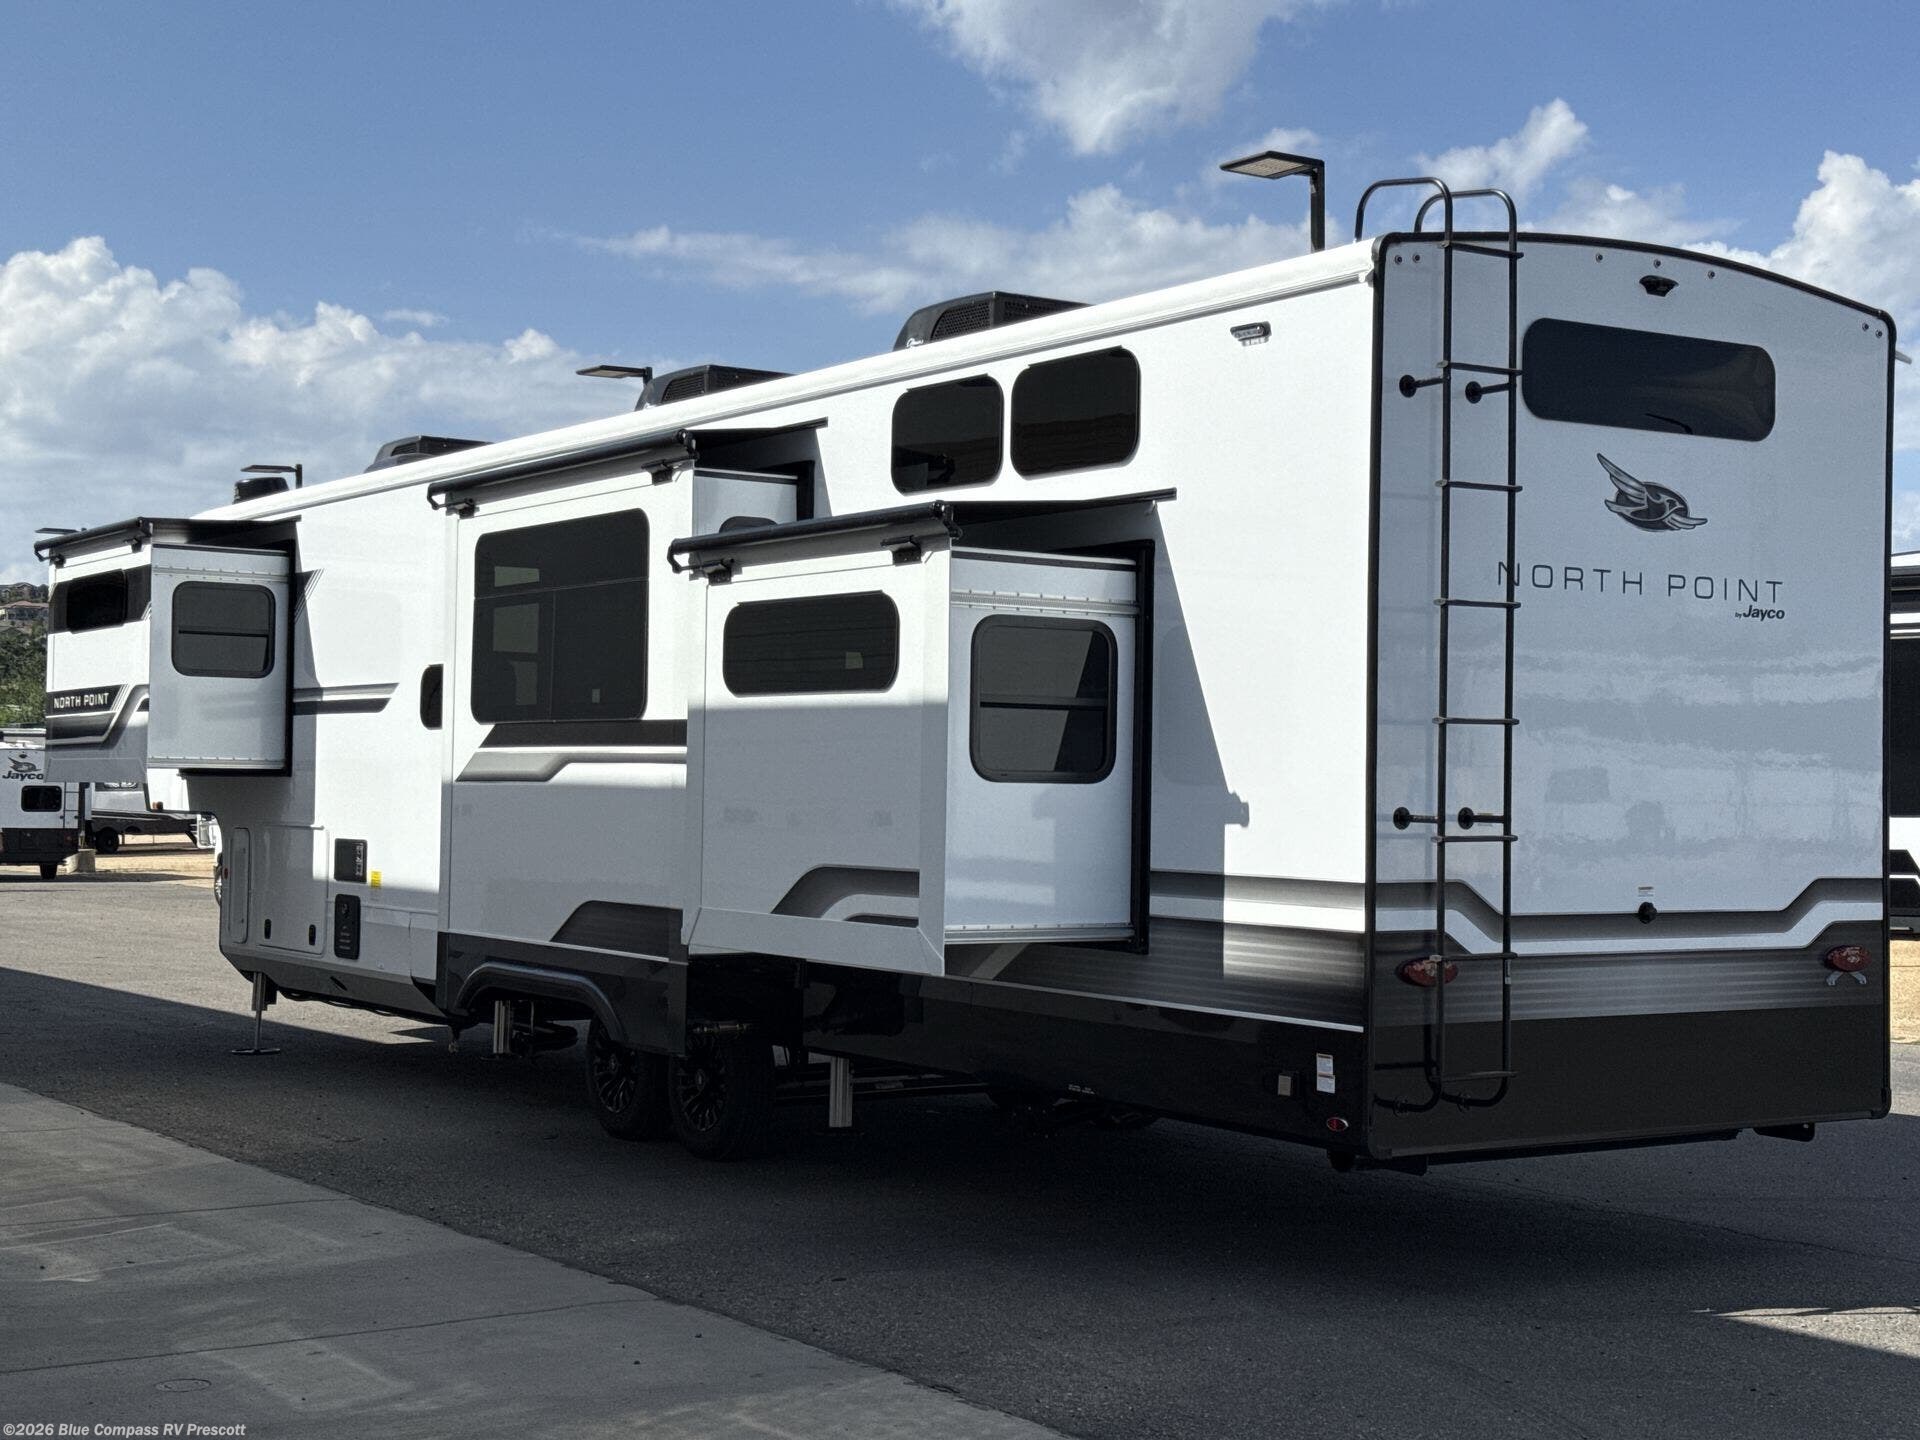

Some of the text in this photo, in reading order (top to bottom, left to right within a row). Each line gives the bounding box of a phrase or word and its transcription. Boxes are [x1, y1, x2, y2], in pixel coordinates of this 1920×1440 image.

[1497, 561, 1783, 603] NORTH POINT
[1742, 604, 1786, 622] Jayco
[53, 692, 110, 709] NORTH POINT
[2, 770, 44, 781] Jayco
